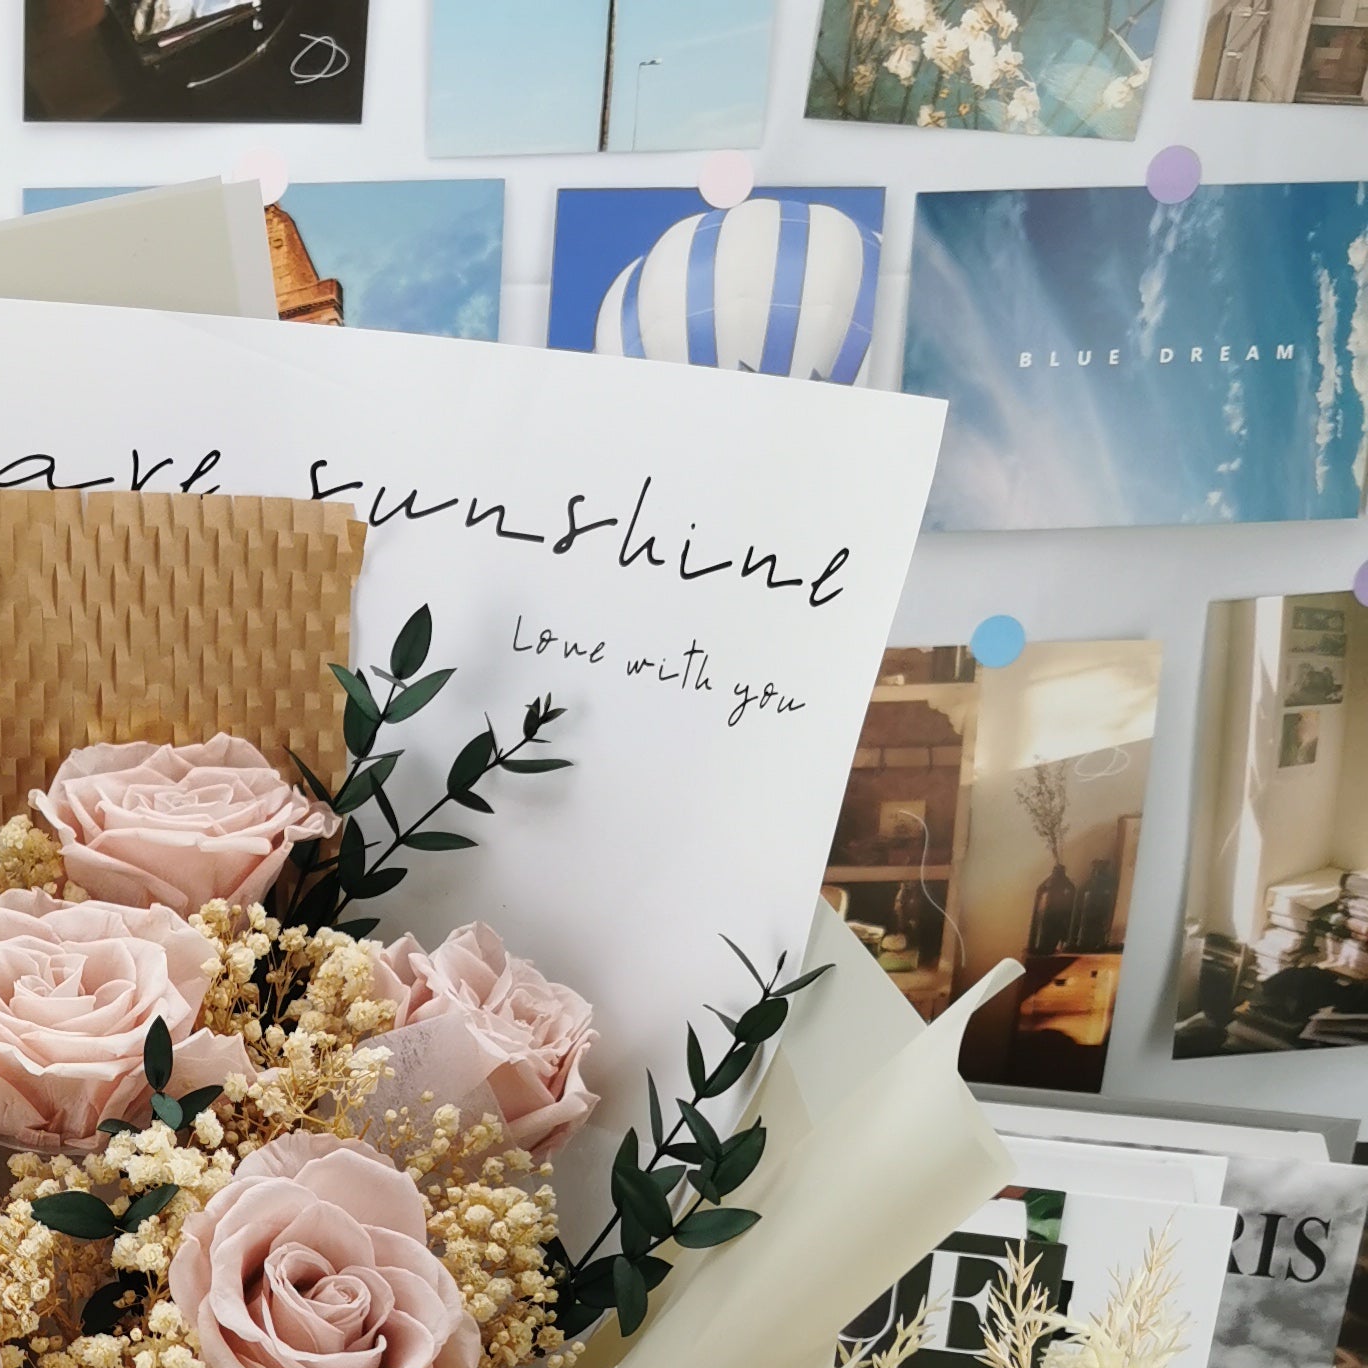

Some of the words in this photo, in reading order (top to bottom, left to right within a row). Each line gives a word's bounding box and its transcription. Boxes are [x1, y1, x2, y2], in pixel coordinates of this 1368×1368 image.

[1019, 349, 1121, 368] BLUE
[1159, 344, 1295, 364] DREAM
[308, 458, 851, 608] sunshine
[626, 638, 713, 691] with
[727, 682, 807, 728] you
